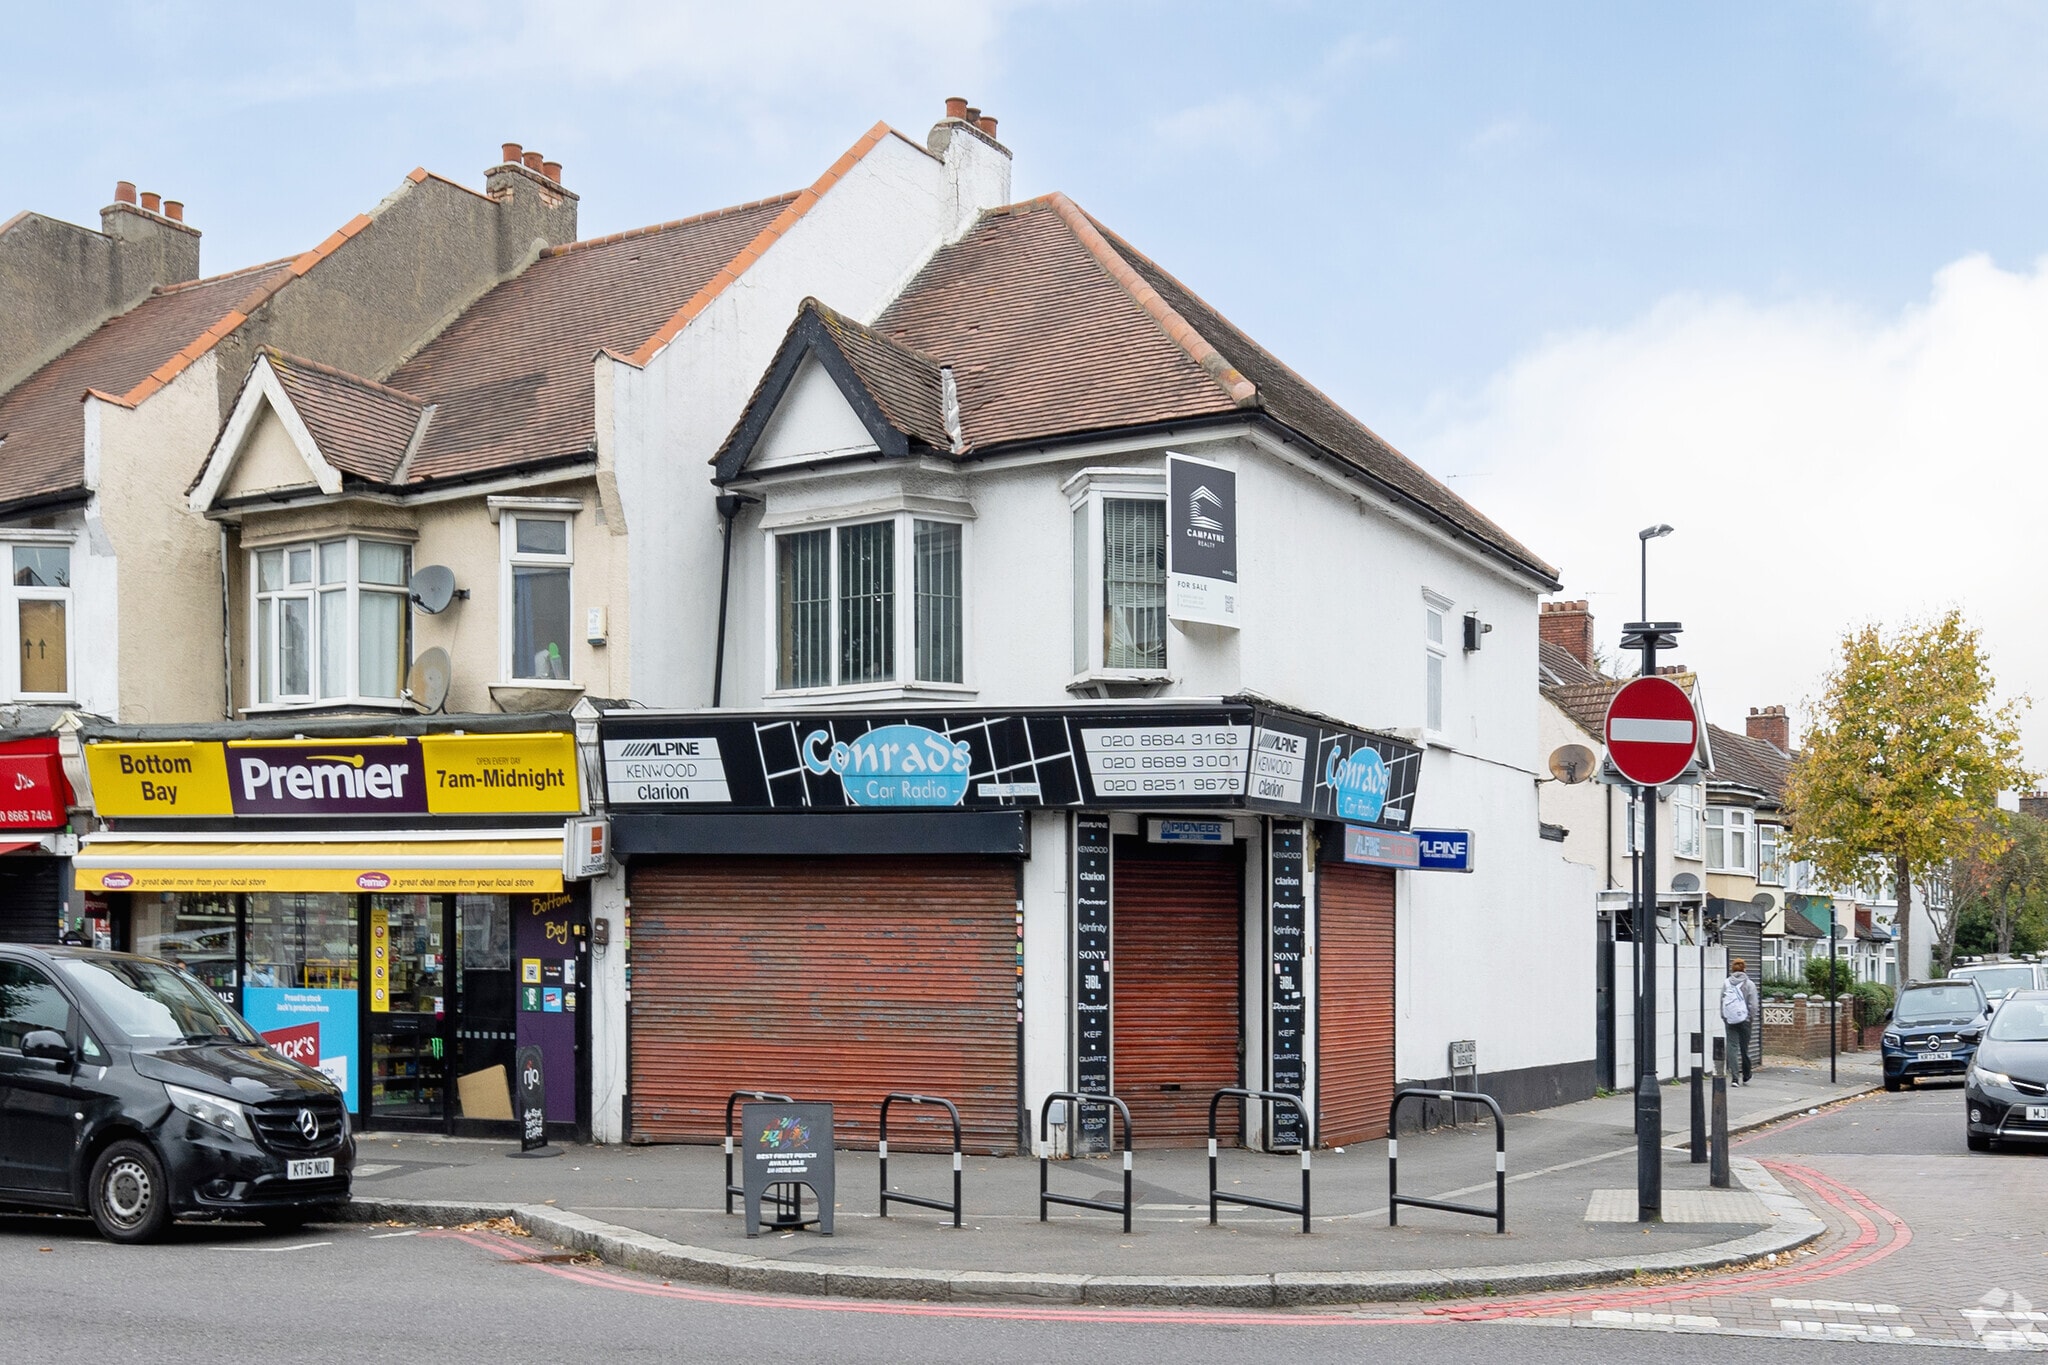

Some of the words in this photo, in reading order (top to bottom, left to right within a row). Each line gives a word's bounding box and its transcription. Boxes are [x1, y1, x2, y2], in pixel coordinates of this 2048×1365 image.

[1186, 528, 1225, 543] CAMPAYNE
[1177, 580, 1190, 589] FOR
[1192, 582, 1207, 591] SALE
[1101, 735, 1135, 748] 020
[1140, 734, 1185, 747] 8684
[1191, 733, 1238, 746] 3163
[802, 729, 972, 776] Conrads
[120, 754, 193, 775] Bottom
[510, 757, 521, 765] DAY
[1102, 757, 1136, 769] 020
[1141, 756, 1187, 768] 8689
[1192, 755, 1239, 768] 3001
[1258, 755, 1293, 776] KENWOOD
[626, 763, 697, 778] KENWOOD
[1326, 745, 1390, 796] Conrads
[240, 757, 409, 800] Premier
[436, 768, 565, 791] 7am-Midnight
[1103, 779, 1137, 792] 020
[1142, 779, 1185, 792] 8251
[1193, 778, 1240, 790] 9679
[141, 781, 178, 805] Bay
[866, 780, 896, 799] Car
[901, 779, 948, 799] Radio
[1344, 796, 1357, 815] Car
[1358, 799, 1375, 818] Radio
[7, 810, 30, 822] 8665
[30, 810, 53, 821] 7464
[1171, 822, 1222, 833] PIONEER
[1078, 846, 1108, 854] KENWOOD
[1420, 840, 1466, 855] ALPINE
[1273, 851, 1302, 859] KENWOOD
[104, 876, 131, 887] Premier
[141, 878, 159, 887] great
[160, 877, 174, 885] deal
[213, 879, 229, 887] your
[230, 877, 247, 885] local
[359, 876, 388, 887] Premier
[398, 879, 418, 888] great
[419, 878, 436, 886] deal
[458, 878, 475, 886] from
[476, 880, 494, 888] your
[495, 878, 514, 886] local
[531, 893, 573, 916] Bottom
[1078, 897, 1107, 906] Pioneer
[1273, 901, 1301, 909] Pioneer
[545, 920, 568, 945] Bay
[1079, 951, 1107, 960] SONY
[1273, 952, 1300, 961] SONY
[1085, 975, 1101, 990] JBL
[1279, 976, 1295, 990] JBL
[215, 991, 234, 1004] ALS
[284, 994, 299, 1002] Proud
[306, 994, 321, 1002] stock
[316, 1004, 330, 1012] here
[1084, 1031, 1102, 1039] KEF
[1278, 1029, 1296, 1037] KEF
[2033, 1108, 2048, 1119] MJ
[293, 1161, 313, 1177] KT15
[314, 1160, 330, 1175] NUO
